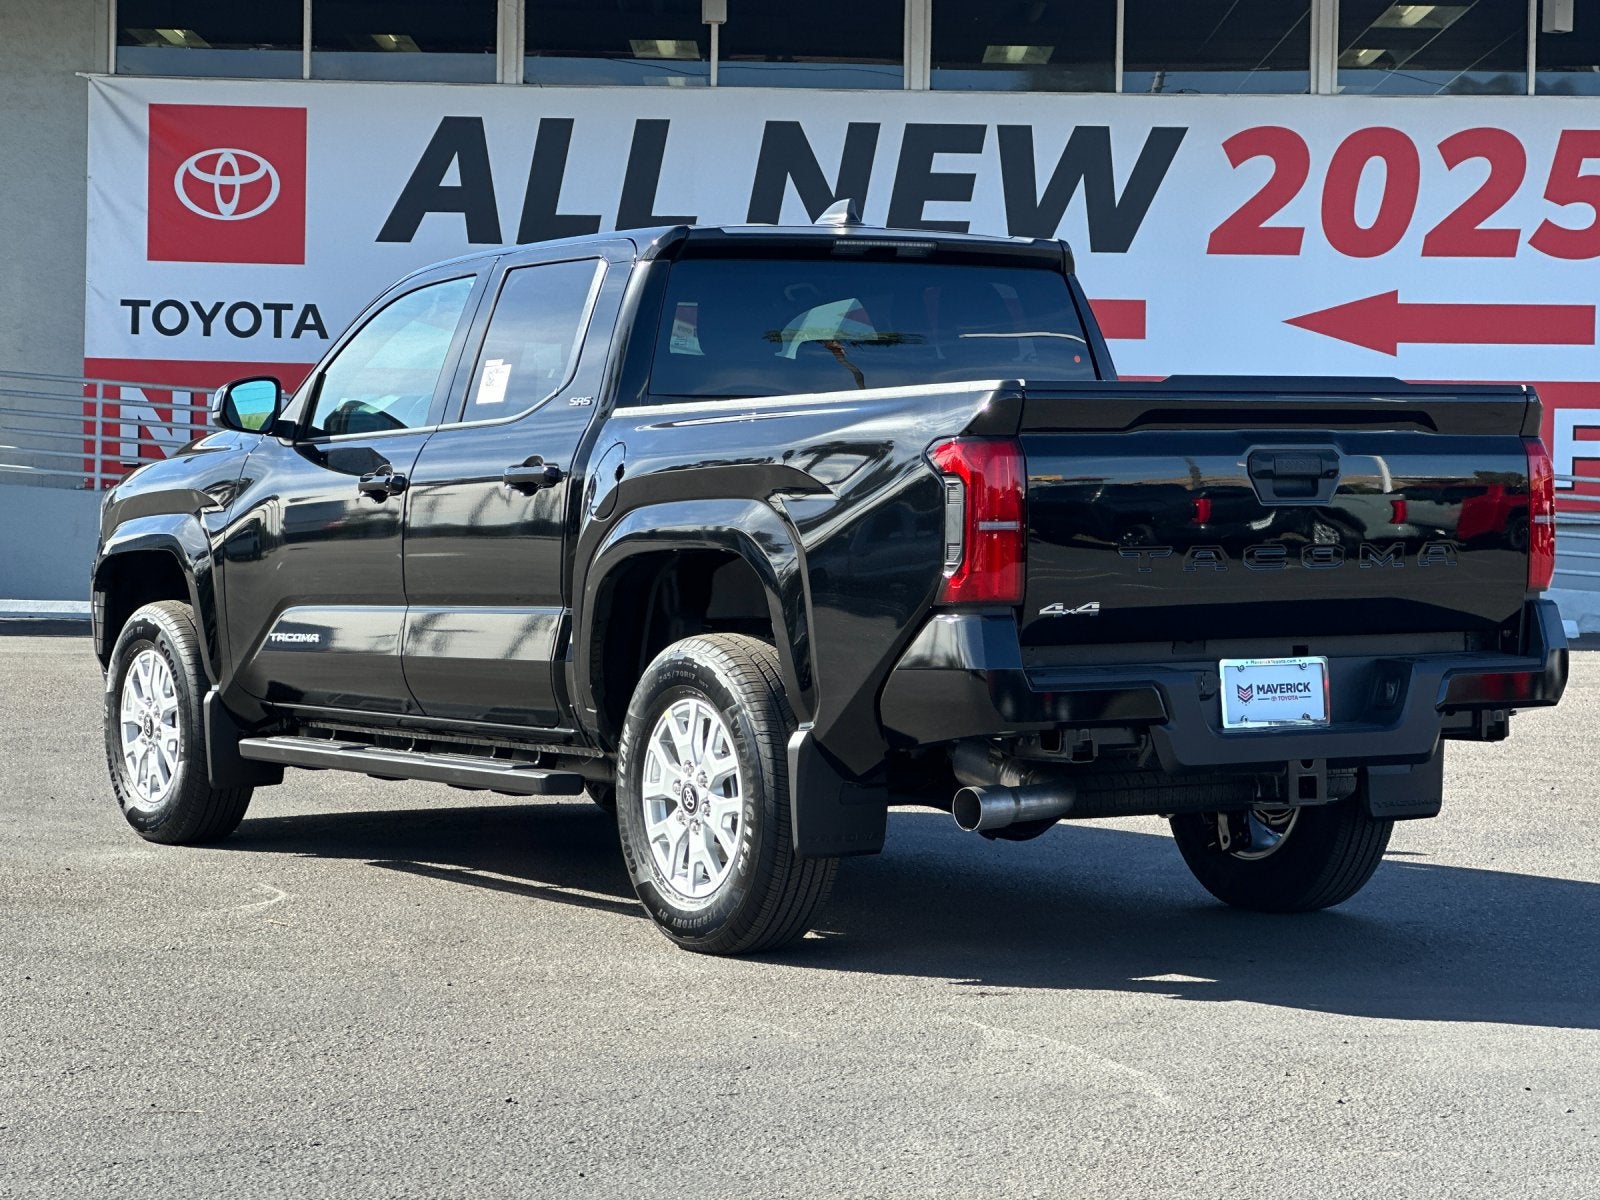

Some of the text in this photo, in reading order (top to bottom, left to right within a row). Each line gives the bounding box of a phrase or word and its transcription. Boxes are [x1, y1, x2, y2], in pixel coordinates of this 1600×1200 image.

[374, 116, 1600, 260] ALL NEW 2025
[119, 298, 330, 340] TOYOTA
[568, 396, 594, 407] SR5
[1117, 541, 1460, 574] TACOMA
[269, 632, 321, 644] TACOMA
[1256, 681, 1312, 695] MAVERICK
